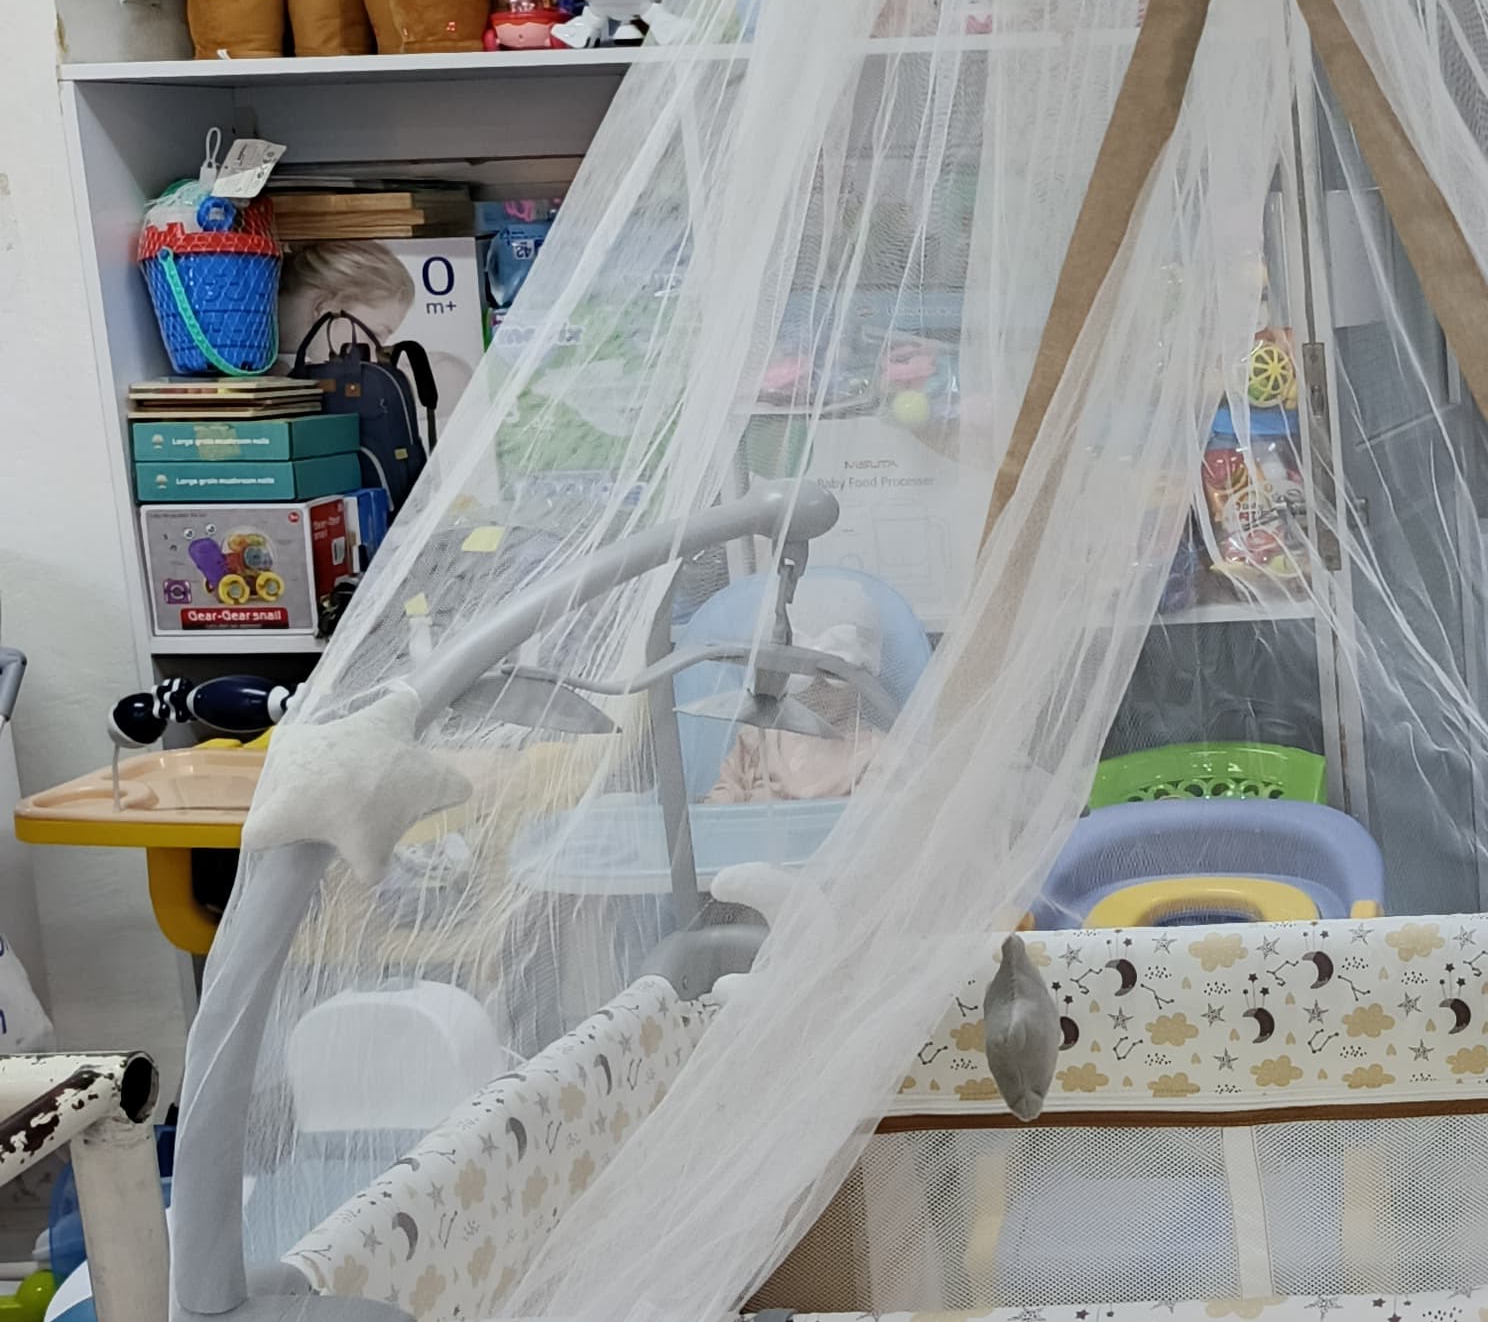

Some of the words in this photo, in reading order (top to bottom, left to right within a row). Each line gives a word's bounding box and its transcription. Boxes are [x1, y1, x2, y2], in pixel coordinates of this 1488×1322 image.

[426, 301, 457, 314] m+
[172, 438, 194, 446] Large
[848, 477, 877, 487] Food
[188, 610, 251, 622] Gear-Gear
[252, 609, 282, 621] snail
